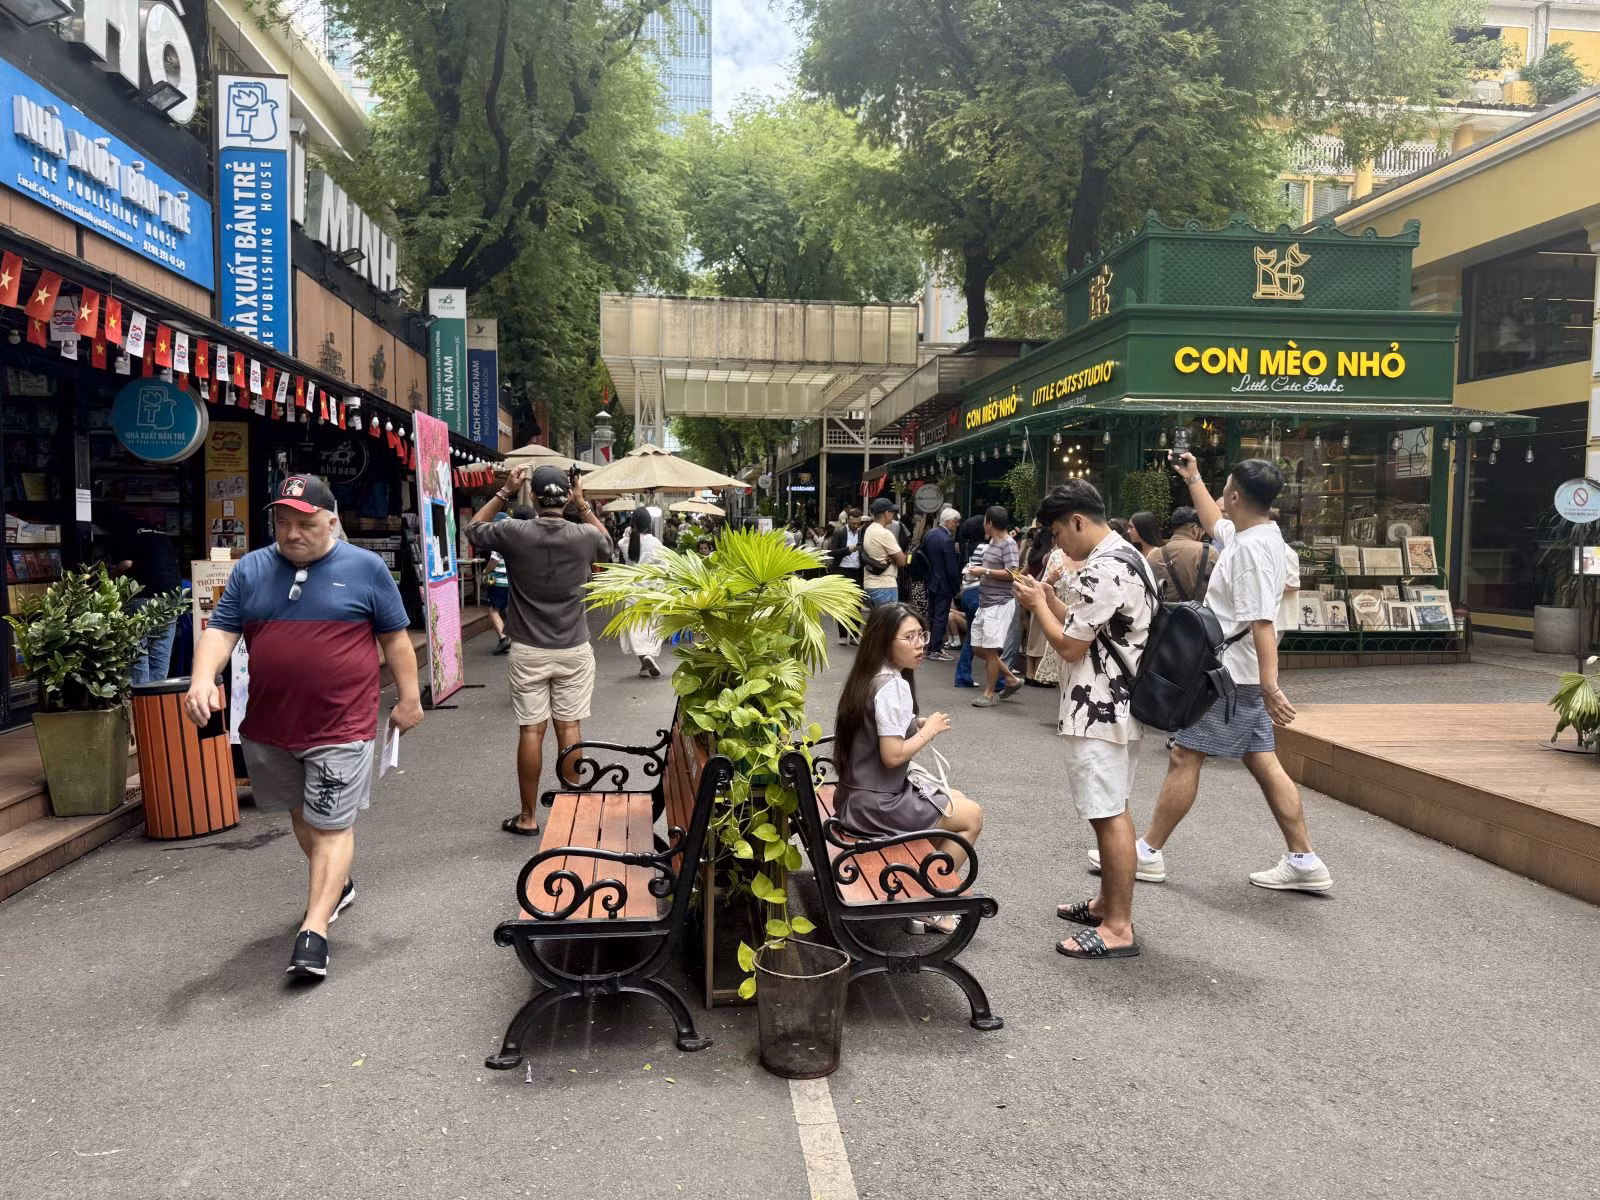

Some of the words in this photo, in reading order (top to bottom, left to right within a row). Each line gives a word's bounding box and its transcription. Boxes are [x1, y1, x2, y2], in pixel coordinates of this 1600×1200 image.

[13, 95, 67, 160] NHÀ
[67, 137, 120, 191] XUẤT
[120, 160, 159, 216] BẢN
[159, 191, 191, 234] TRẺ
[225, 161, 256, 200] TRẺ
[32, 156, 57, 183] TRE
[68, 176, 138, 229] PUBLISHING
[146, 221, 176, 250] HOUSE
[260, 161, 272, 211] HOUSE
[225, 206, 257, 248] BẢN
[308, 170, 397, 292] MINH
[227, 253, 258, 307] XUẤT
[261, 228, 273, 321] PUBLISHING
[230, 312, 258, 340] HÀ
[443, 356, 454, 382] NAM
[472, 361, 480, 379] NAM
[1175, 346, 1248, 374] CON
[1260, 340, 1328, 377] MÈO
[1337, 342, 1405, 378] NHỎ
[442, 386, 454, 410] NHÃ
[1032, 382, 1055, 406] LITTLE
[1056, 373, 1077, 398] CATS
[1077, 360, 1112, 390] STUDIO
[1231, 374, 1270, 392] Little
[966, 407, 981, 430] CON
[982, 396, 998, 425] MÈO
[999, 385, 1017, 418] NHỎ
[472, 417, 481, 441] SÁCH
[338, 467, 357, 475] nam
